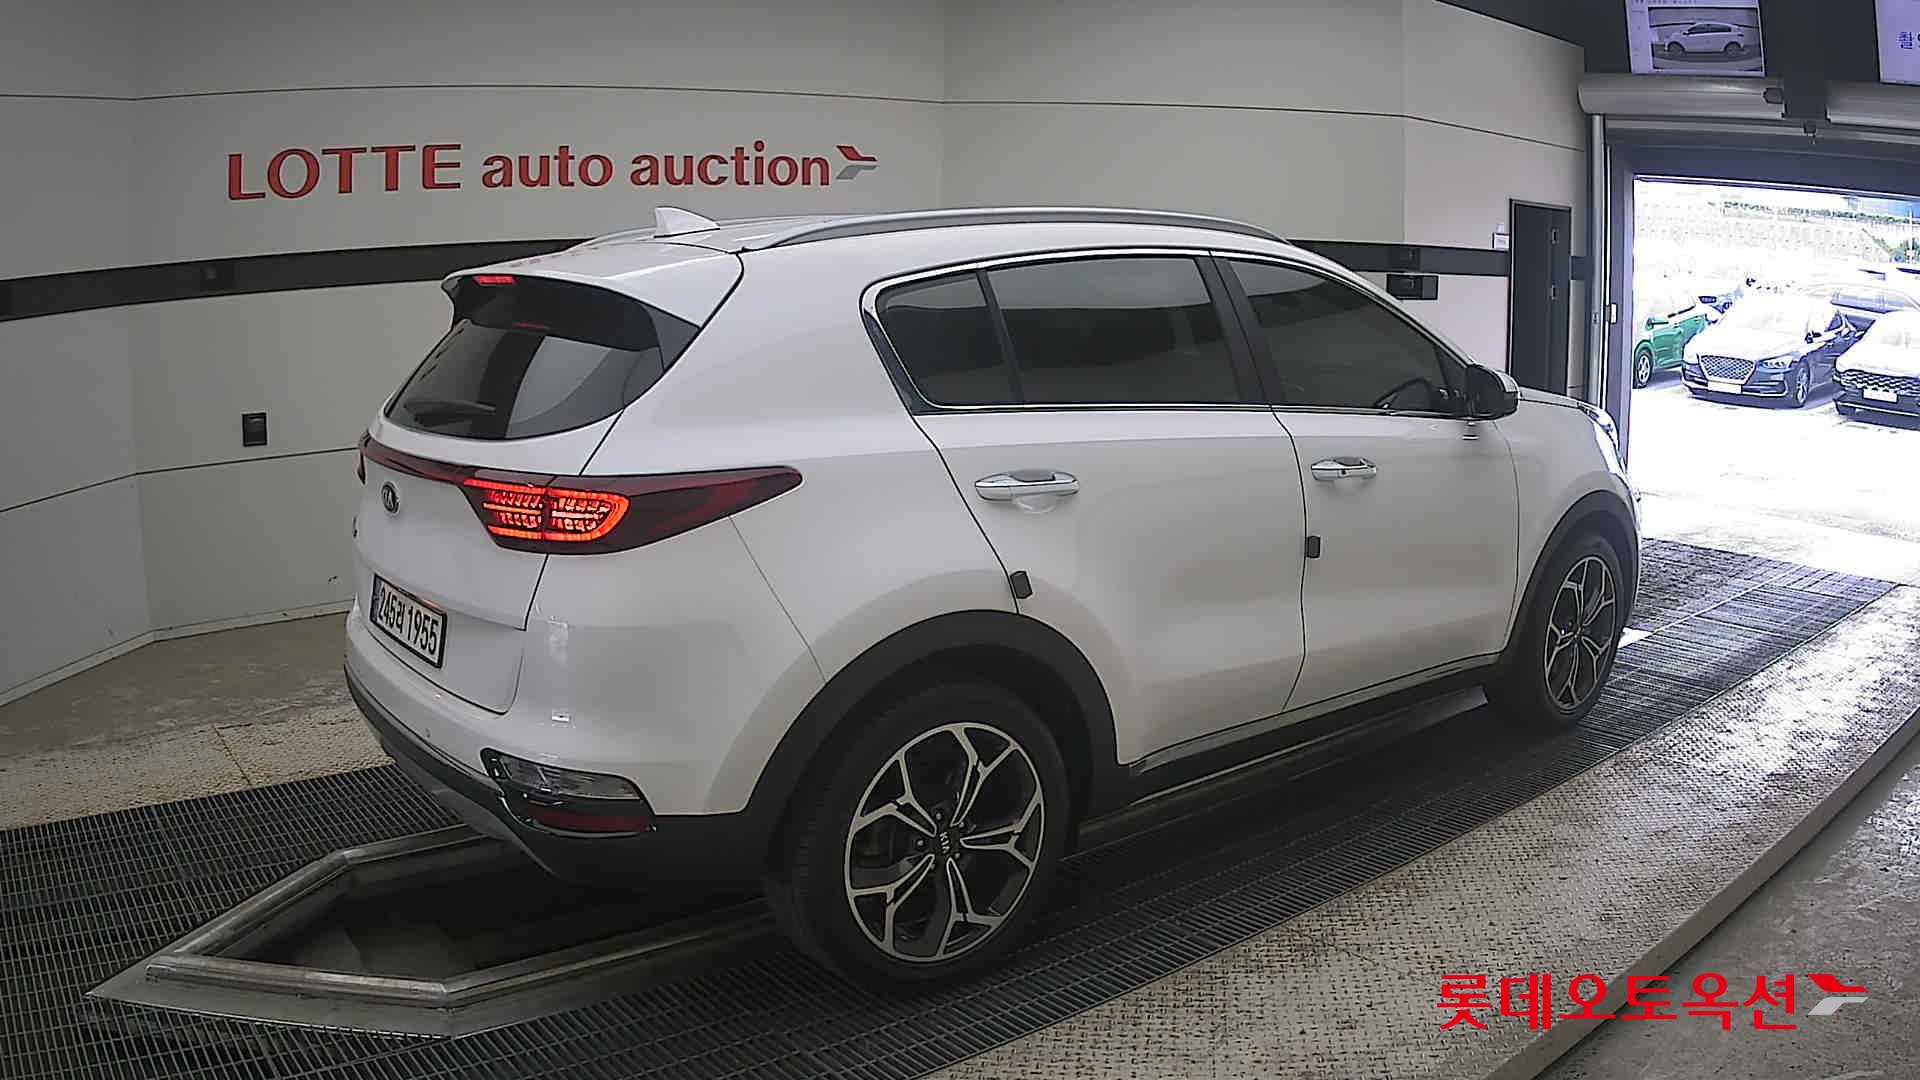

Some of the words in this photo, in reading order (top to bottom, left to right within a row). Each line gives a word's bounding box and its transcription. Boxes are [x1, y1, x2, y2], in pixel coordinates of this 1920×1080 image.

[229, 144, 460, 200] LOTTE
[483, 146, 613, 187] auto
[631, 141, 829, 185] auction
[407, 605, 439, 655] 1955
